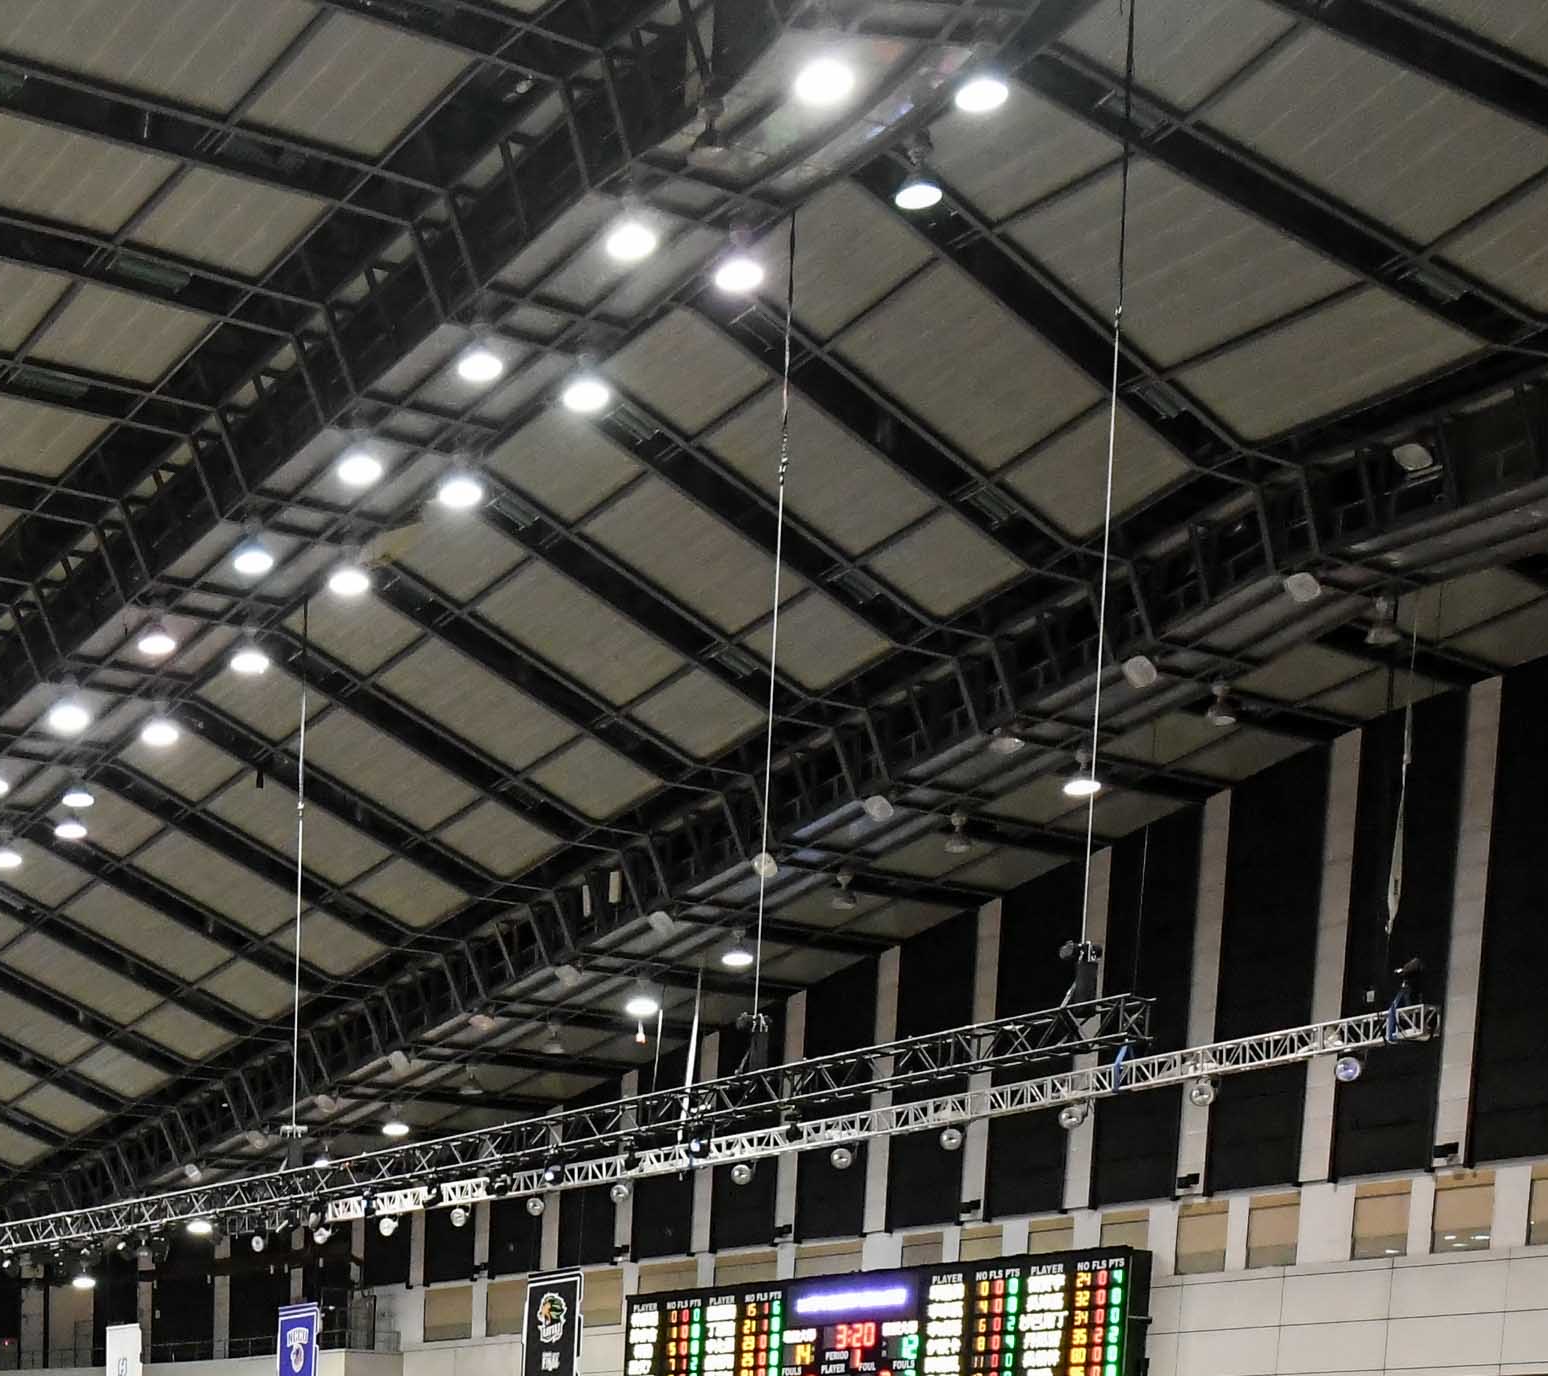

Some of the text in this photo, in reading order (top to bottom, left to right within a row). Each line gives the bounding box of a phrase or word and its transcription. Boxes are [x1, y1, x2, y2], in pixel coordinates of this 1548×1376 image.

[932, 1258, 1124, 1284] PLAYER NO FLS PTS PLAYER NO FLS PTS
[633, 1302, 657, 1312] PLAYER
[710, 1296, 735, 1305] PLAYER
[836, 1322, 876, 1349] 3:20
[826, 1351, 848, 1361] PERIOD
[782, 1359, 915, 1376] FOULS PLAYER FOUL FOULS
